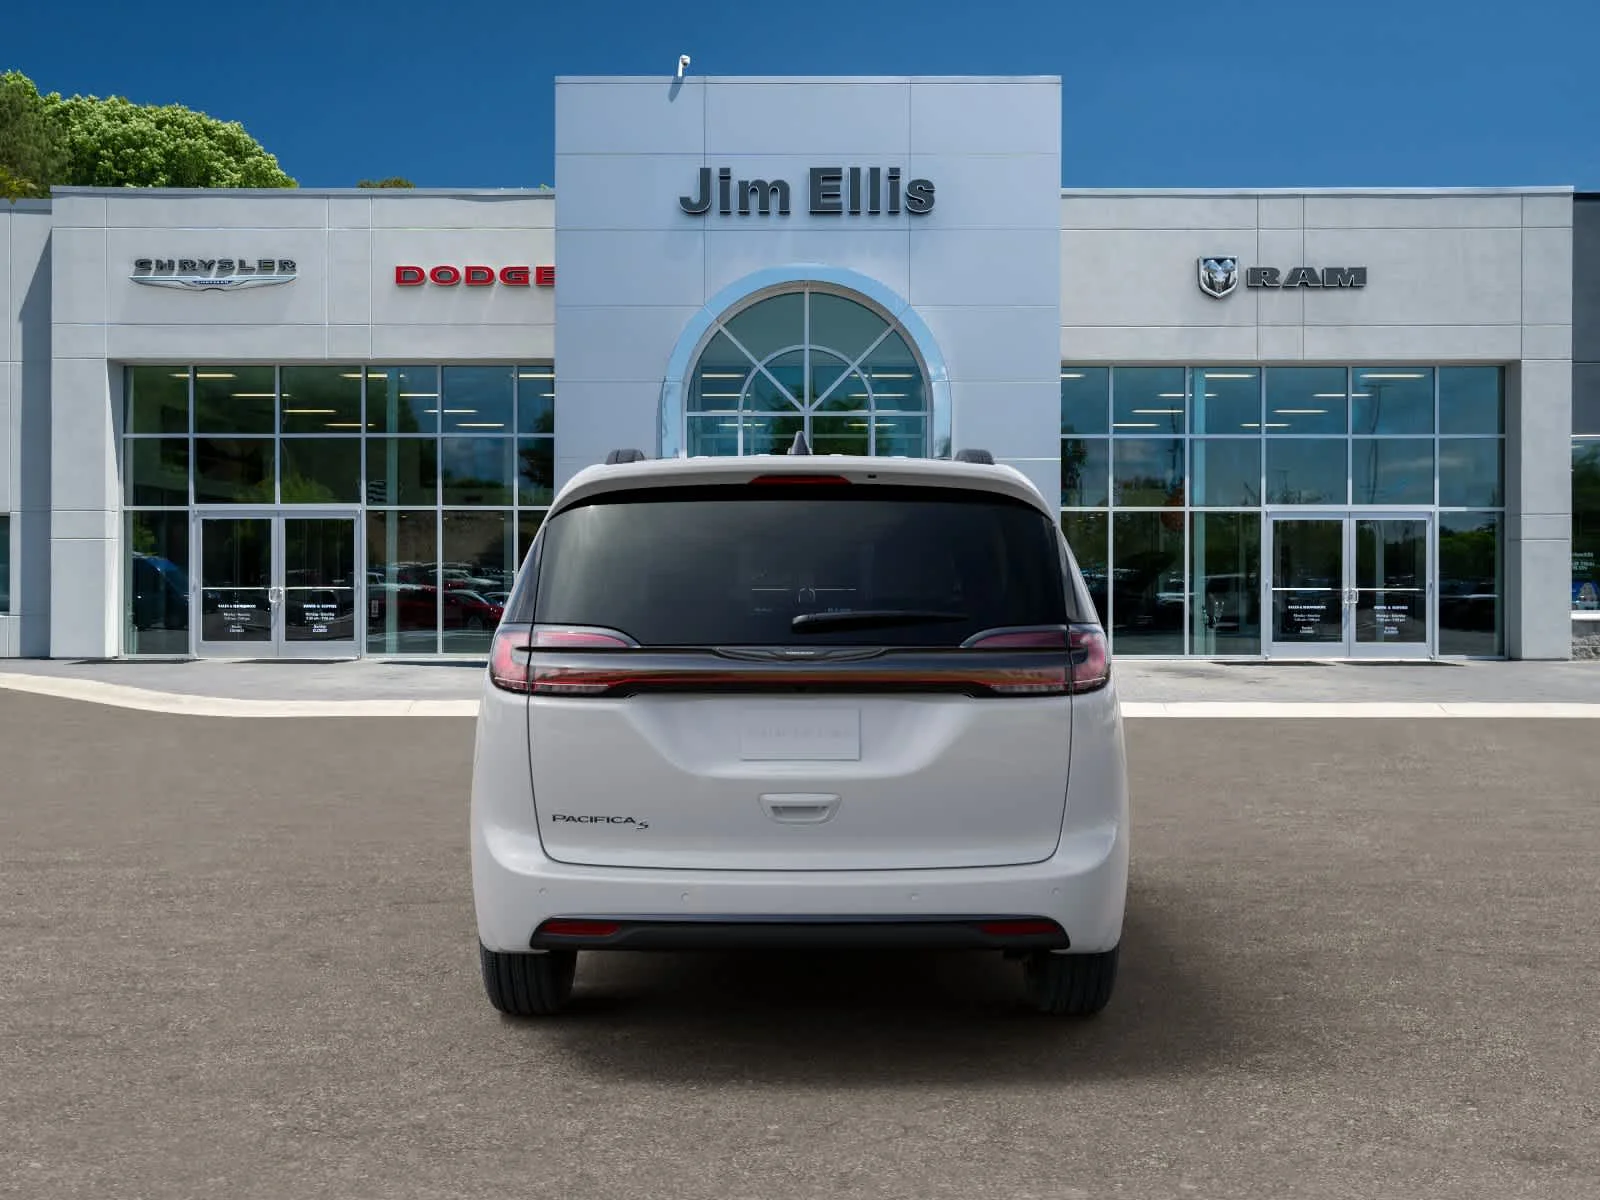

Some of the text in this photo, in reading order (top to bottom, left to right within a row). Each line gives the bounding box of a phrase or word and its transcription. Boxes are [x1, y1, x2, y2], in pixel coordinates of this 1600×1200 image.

[679, 167, 936, 215] Jim Ellis
[134, 258, 297, 272] CHRYSLER
[395, 265, 556, 287] DODGE
[1246, 266, 1368, 288] RAM
[552, 814, 636, 824] PACIFICA
